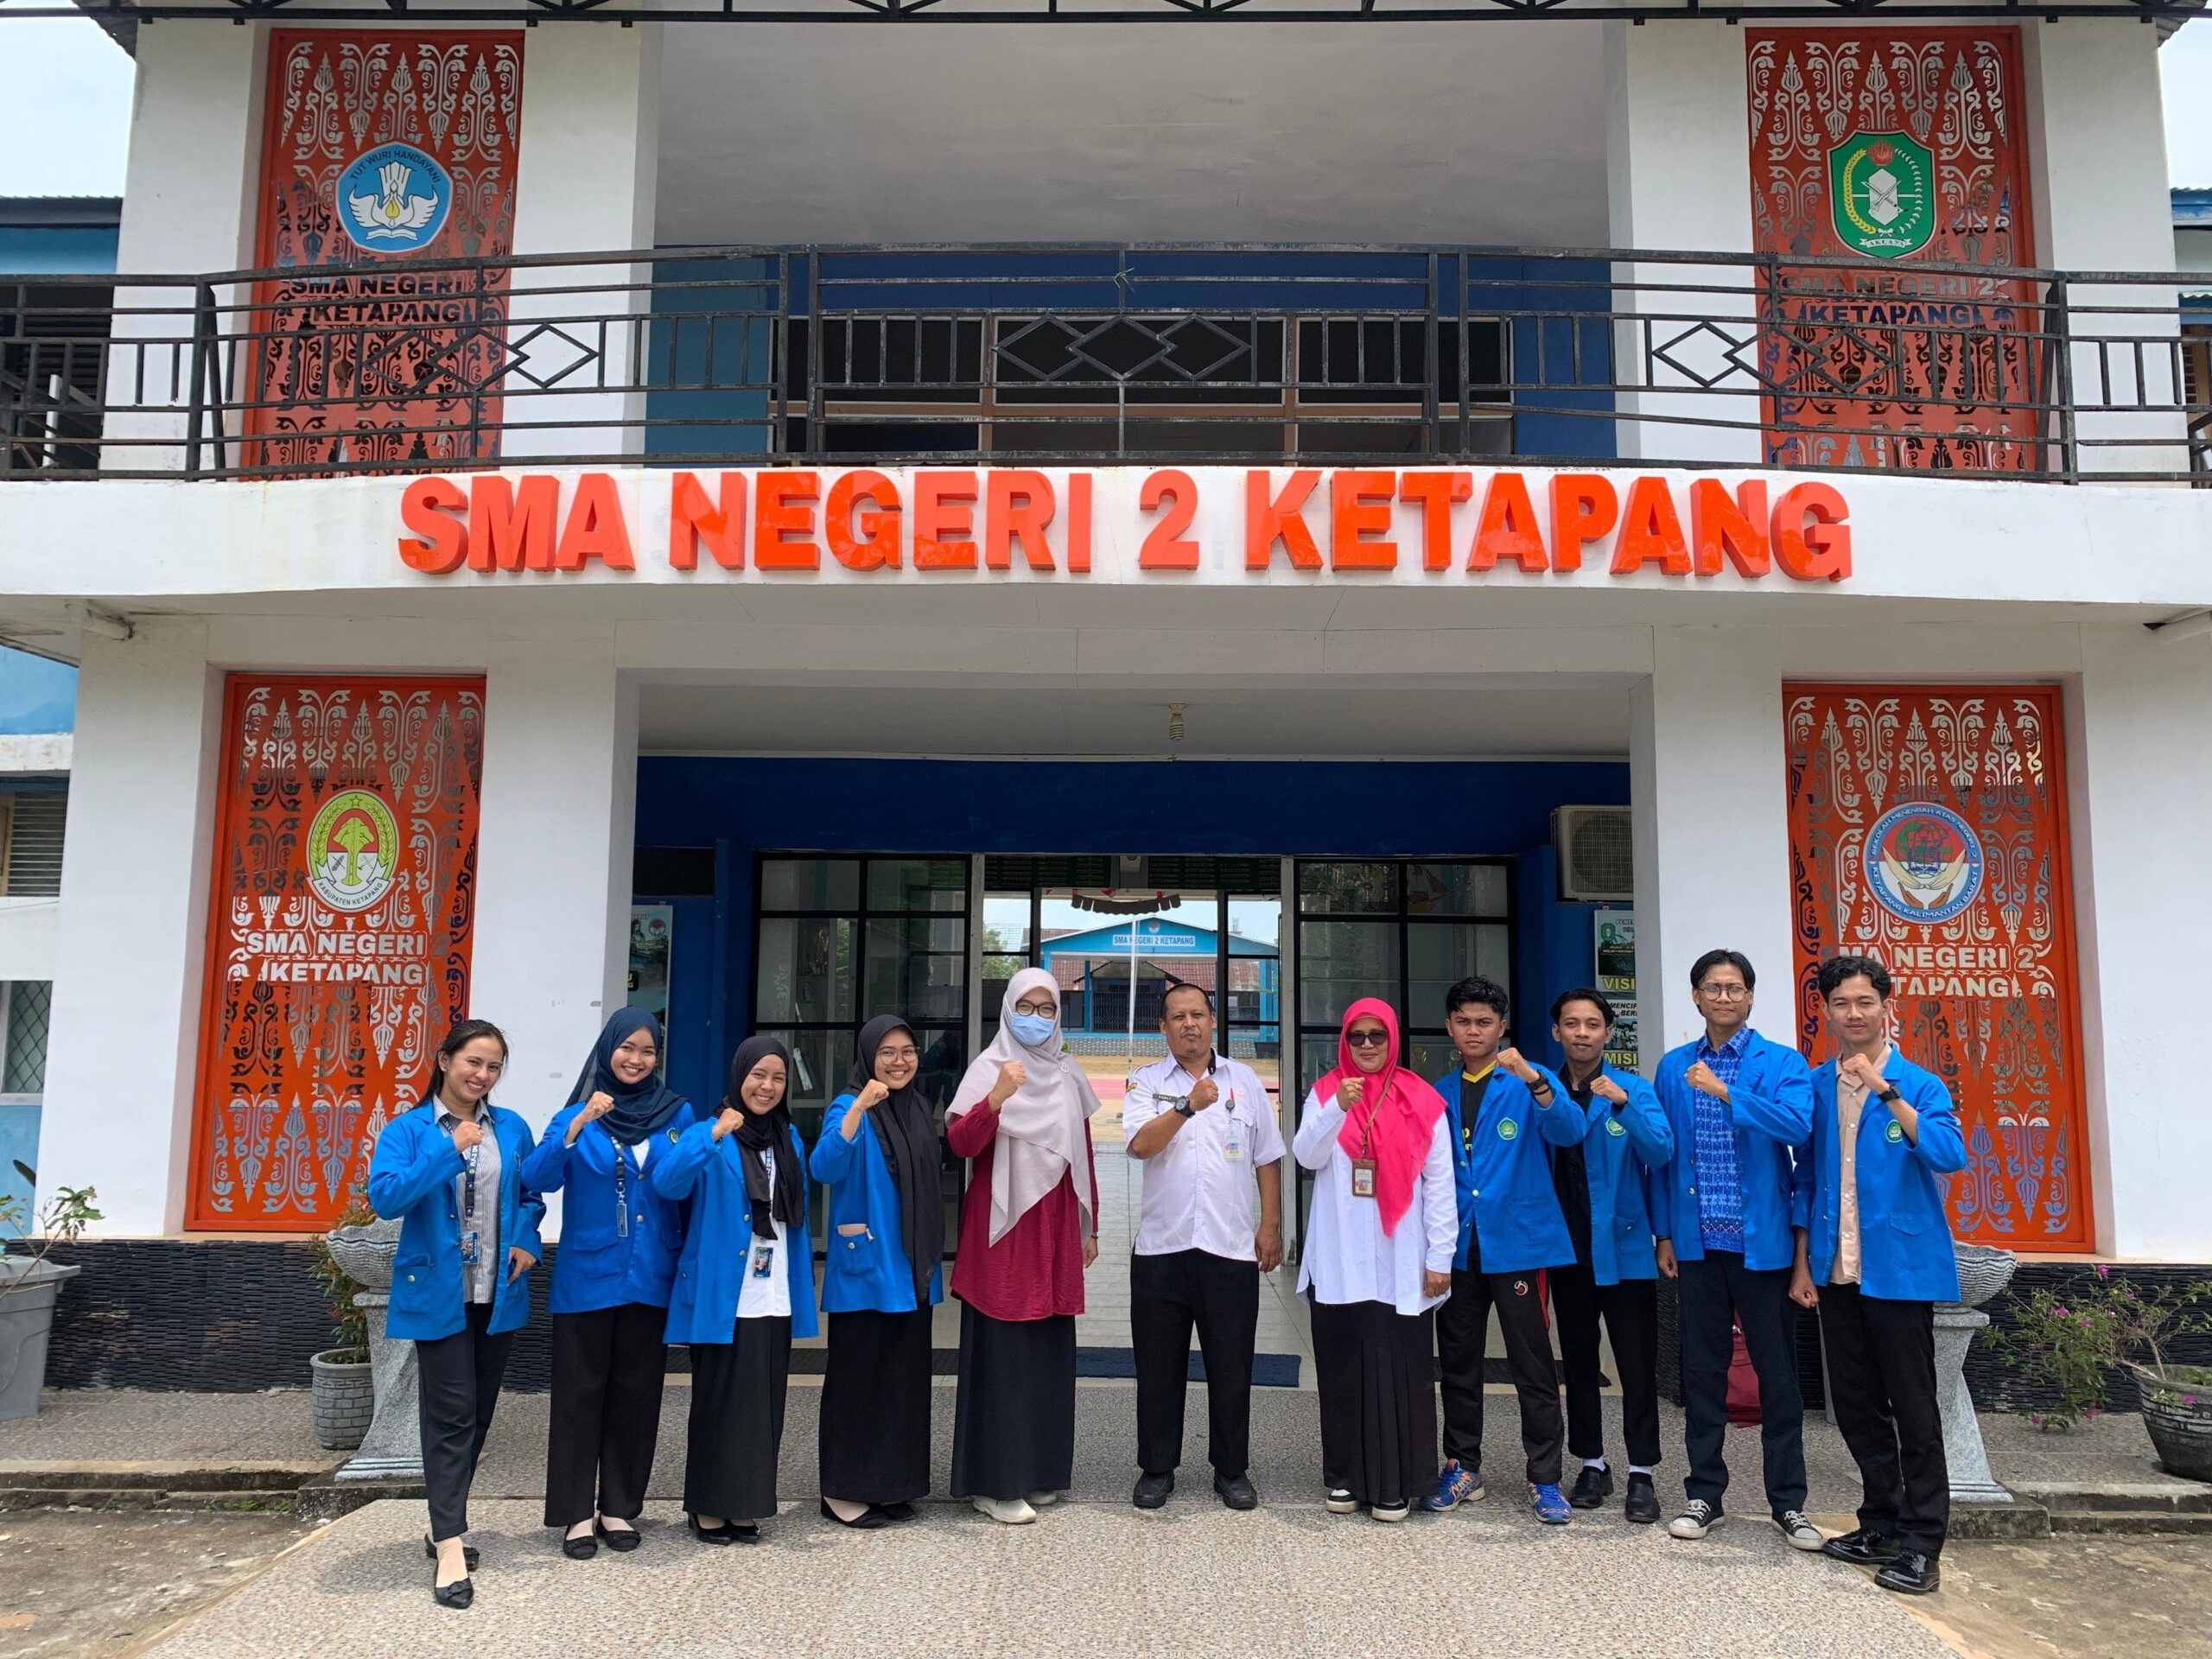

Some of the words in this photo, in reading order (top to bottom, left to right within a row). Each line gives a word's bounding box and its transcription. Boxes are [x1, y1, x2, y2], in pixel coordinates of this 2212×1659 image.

[350, 164, 366, 180] TUT
[366, 151, 391, 165] WURI
[394, 150, 442, 183] HANDAYANI
[291, 276, 349, 295] SMA
[360, 275, 463, 295] NEGERI
[1784, 276, 1843, 293] SMA
[1855, 276, 1967, 296] NEGERI
[1978, 276, 1996, 296] 2
[313, 303, 460, 323] KETAPANG
[1810, 305, 1972, 325] KETAPANG
[398, 473, 636, 575] SMA
[669, 470, 1093, 573] NEGERI
[1139, 469, 1199, 571] 2
[1245, 469, 1852, 582] KETAPANG
[1872, 818, 1891, 855] SEKOLAH
[1935, 810, 1956, 823] ATAS
[1955, 821, 1976, 849] NEGERI
[318, 882, 351, 906] KABUPATEN
[352, 883, 384, 906] KETAPANG
[1872, 867, 1902, 911] KETAPANG
[1904, 902, 1963, 918] KALIMANTAN
[1963, 871, 1978, 902] BARAT
[246, 932, 309, 955] SMA
[318, 934, 423, 956] NEGERI
[434, 936, 448, 956] 2
[1114, 936, 1128, 944] SMA
[1154, 937, 1159, 945] 2
[1160, 937, 1194, 946] KETAPANG
[1892, 946, 2006, 969] NEGERI
[2018, 948, 2035, 969] 2
[270, 962, 423, 985] KETAPANG
[1603, 977, 1636, 990] VISI
[1891, 977, 2007, 998] TAPANG
[1604, 1052, 1638, 1065] MISI
